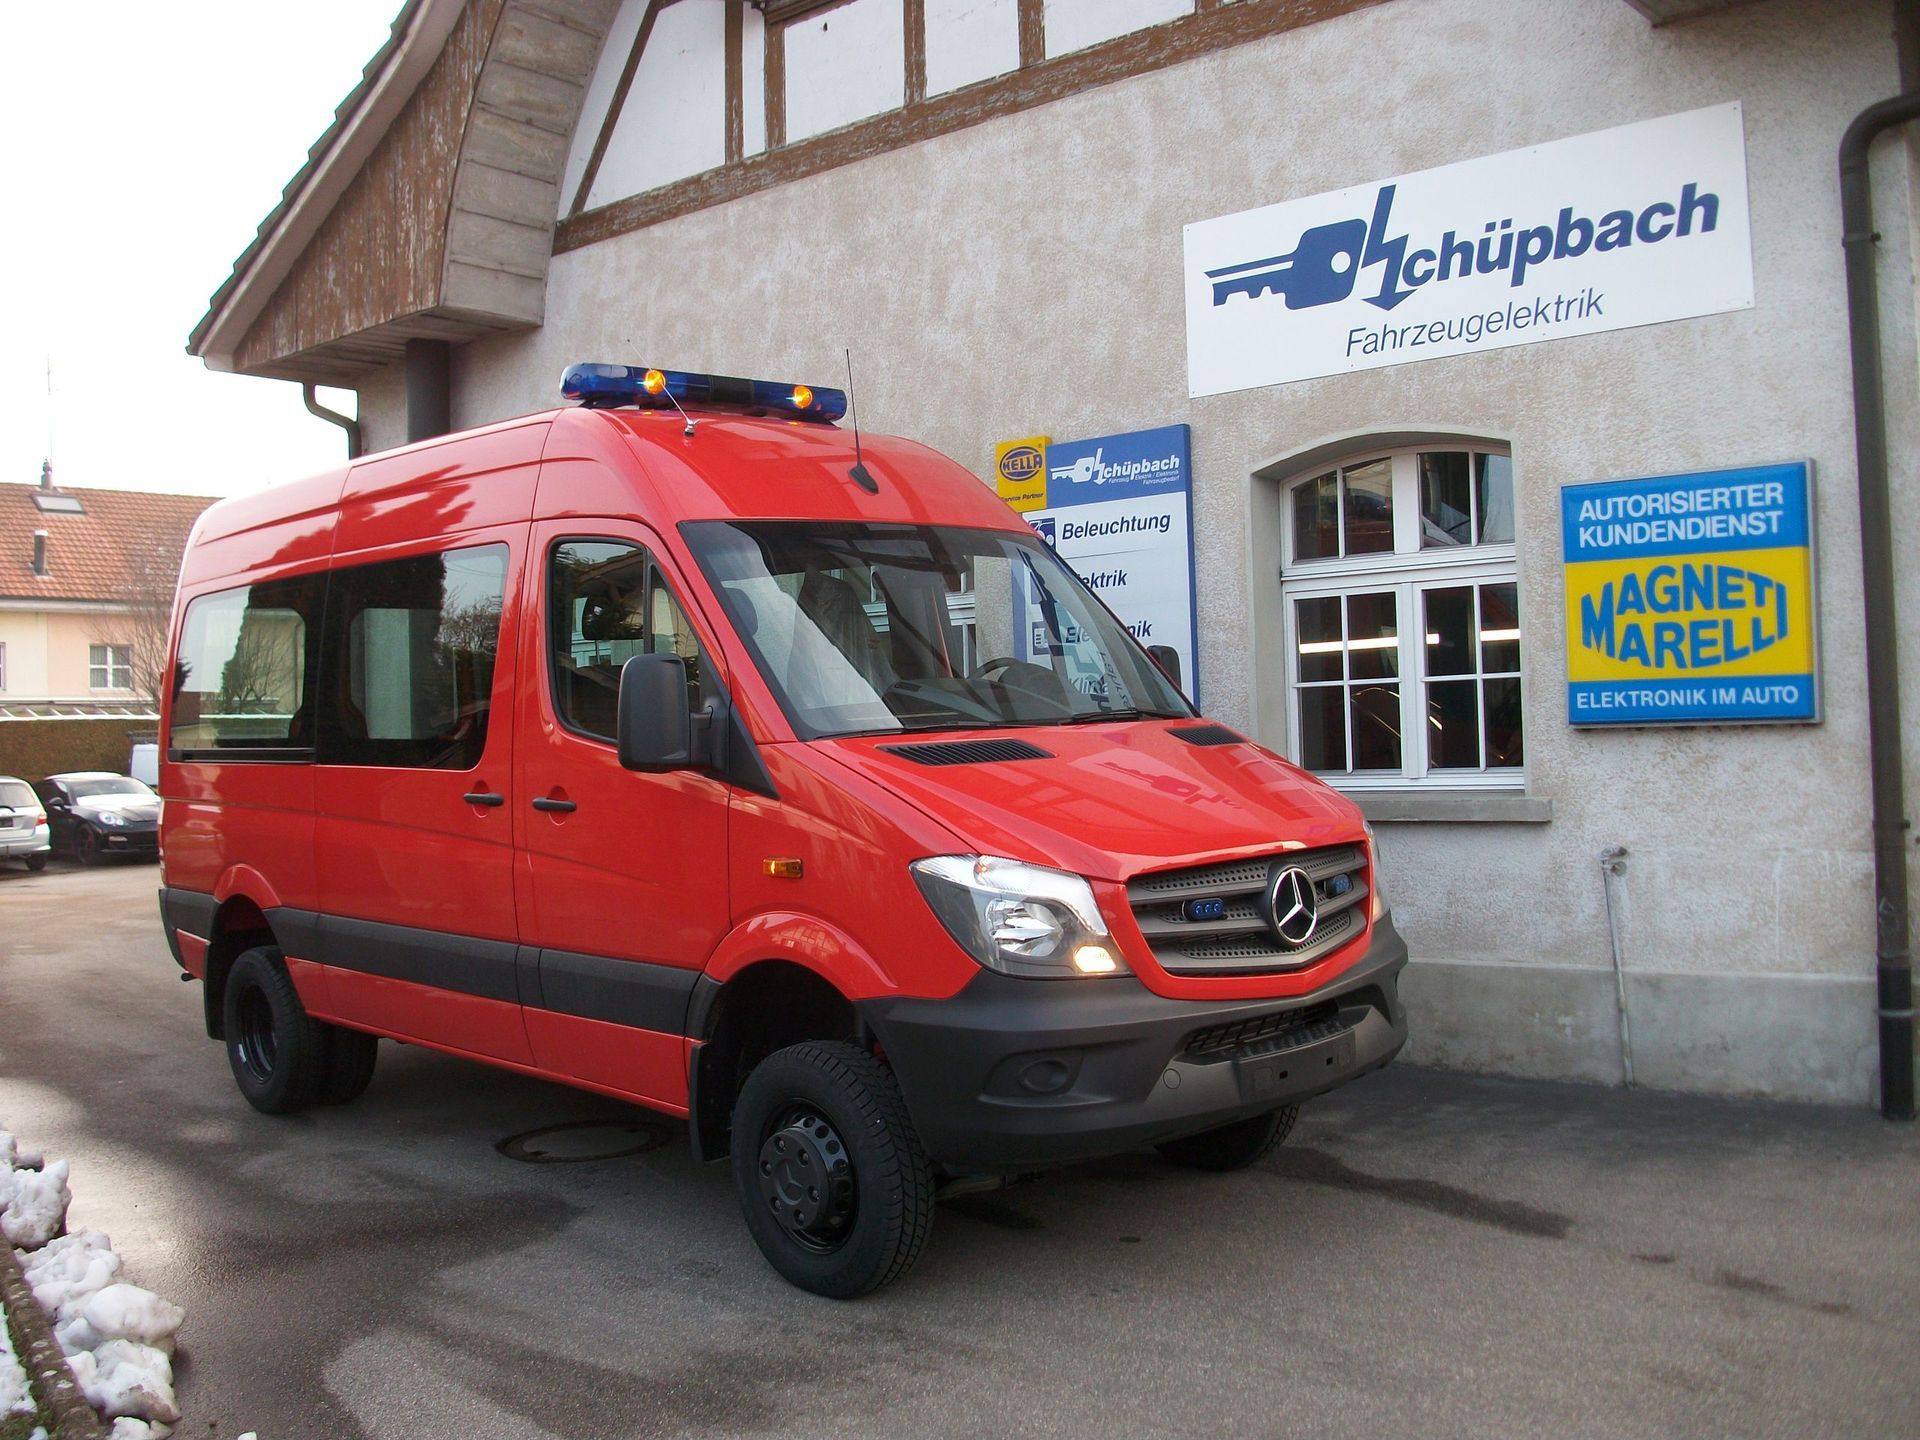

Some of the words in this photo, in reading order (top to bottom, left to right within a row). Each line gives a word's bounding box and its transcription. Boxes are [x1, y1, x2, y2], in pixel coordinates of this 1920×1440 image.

[1346, 288, 1604, 357] Fahrzeugelektrik
[1002, 453, 1043, 471] HELLA
[1578, 482, 1784, 522] AUTORISIERTER
[1062, 514, 1171, 540] Beleuchtung
[1579, 510, 1784, 549] KUNDENDIENST
[1576, 689, 1707, 709] ELEKTRONIK
[1712, 688, 1736, 704] IM
[1741, 685, 1799, 704] AUTO
